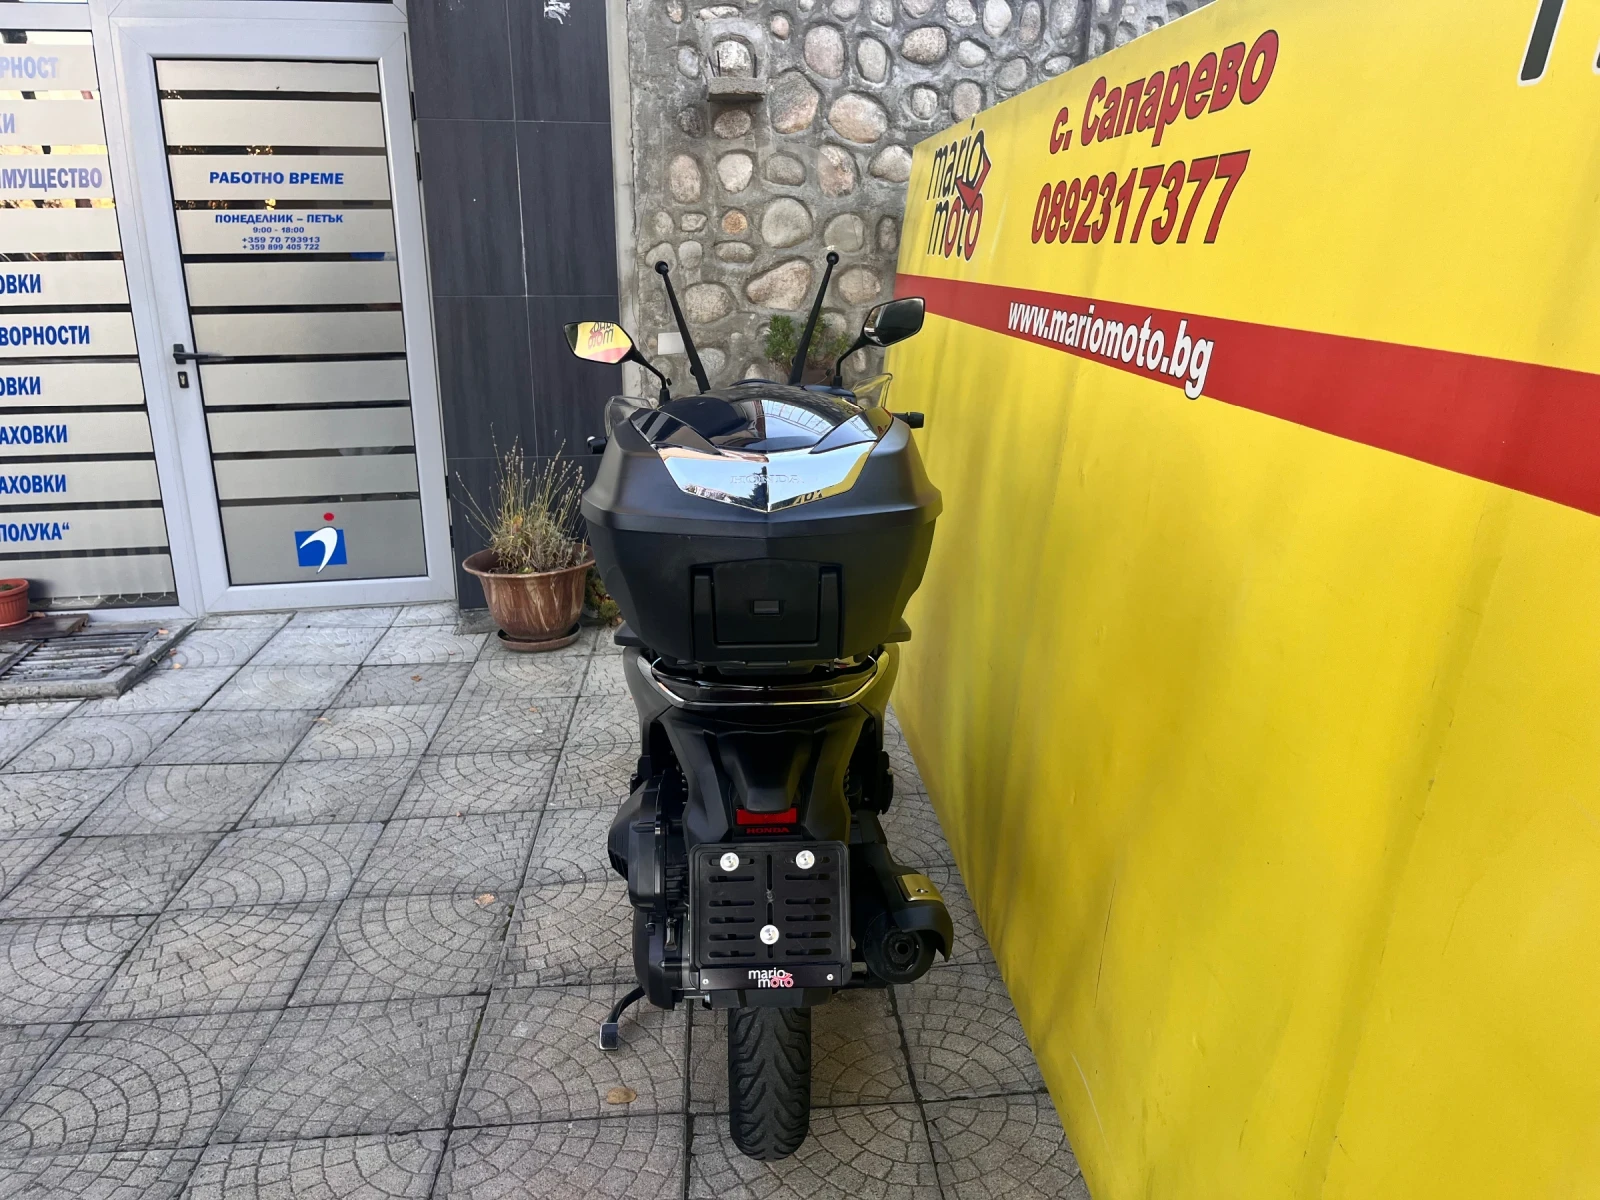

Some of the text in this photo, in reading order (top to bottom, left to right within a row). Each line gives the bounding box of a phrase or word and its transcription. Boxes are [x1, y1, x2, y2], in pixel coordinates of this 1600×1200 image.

[1080, 29, 1280, 147] Сапарево
[0, 113, 15, 134] И
[926, 117, 985, 200] mario
[0, 167, 103, 192] МУЩЕСТВО
[209, 171, 344, 185] РАБОТНО ВРЕМЕ
[1031, 149, 1252, 245] 0892317377
[215, 214, 293, 225] ПОНЕДЕЛНИК
[306, 214, 343, 223] ПЕТЪК
[926, 193, 984, 261] moto
[1007, 301, 1215, 400] www.mariomoto.bg
[0, 425, 68, 445] АХОВКИ
[0, 474, 67, 494] АХОВКИ
[730, 474, 804, 484] HONDA
[748, 967, 786, 979] mario
[757, 976, 794, 988] moto
